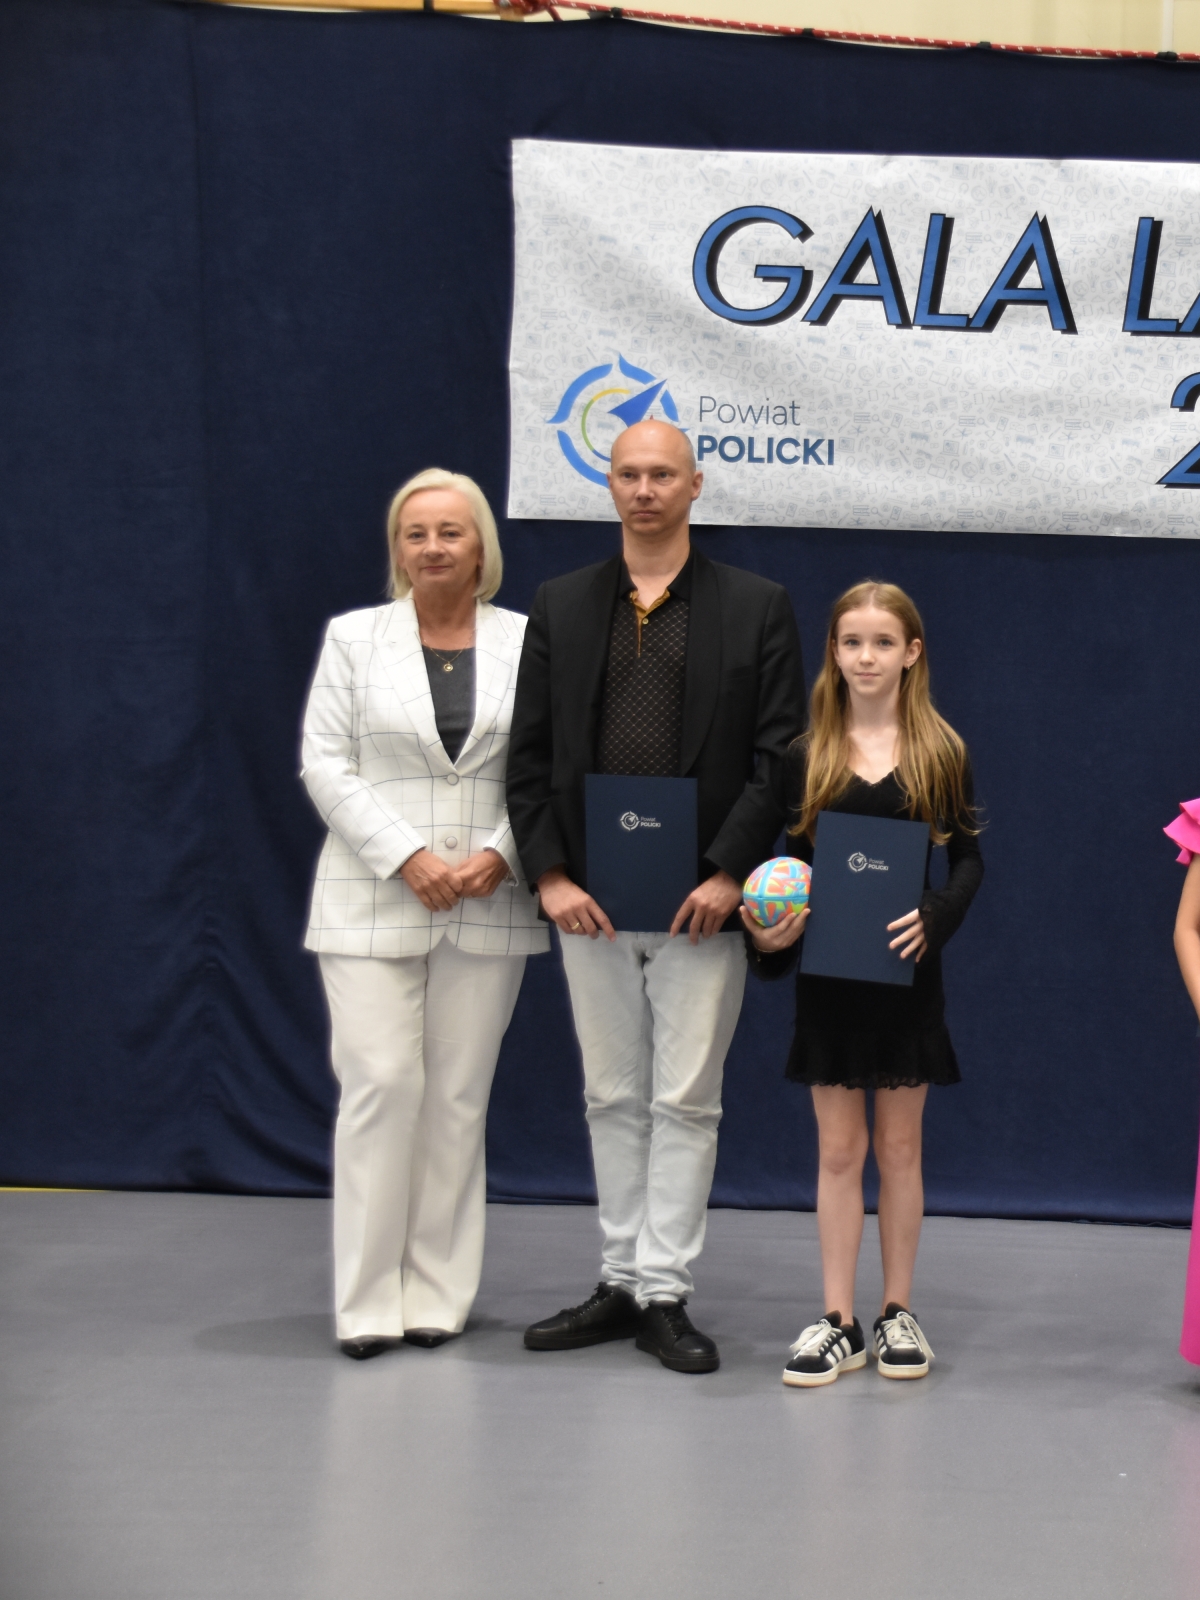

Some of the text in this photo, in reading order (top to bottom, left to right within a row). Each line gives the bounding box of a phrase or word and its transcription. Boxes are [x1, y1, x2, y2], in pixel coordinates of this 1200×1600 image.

[692, 205, 1078, 335] GALA
[699, 395, 801, 426] Powiat
[697, 434, 835, 466] POLICKI
